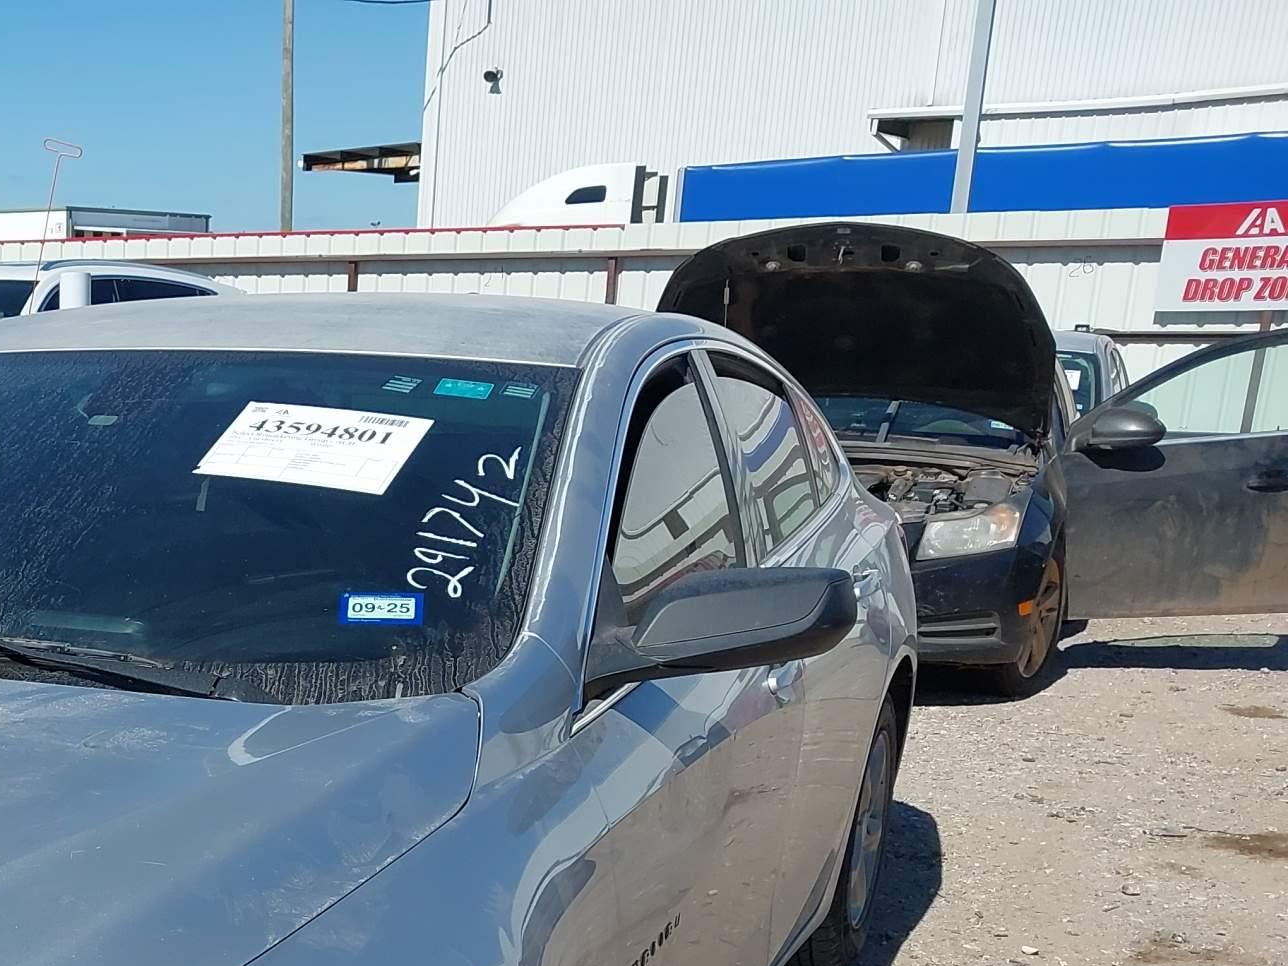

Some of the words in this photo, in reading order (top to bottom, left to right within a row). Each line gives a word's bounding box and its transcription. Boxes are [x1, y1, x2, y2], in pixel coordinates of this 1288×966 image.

[1182, 277, 1253, 302] DROP
[1253, 276, 1288, 302] ZO
[248, 419, 394, 445] 43594801
[406, 446, 523, 598] 291742
[351, 602, 376, 613] 09
[386, 602, 410, 614] 25
